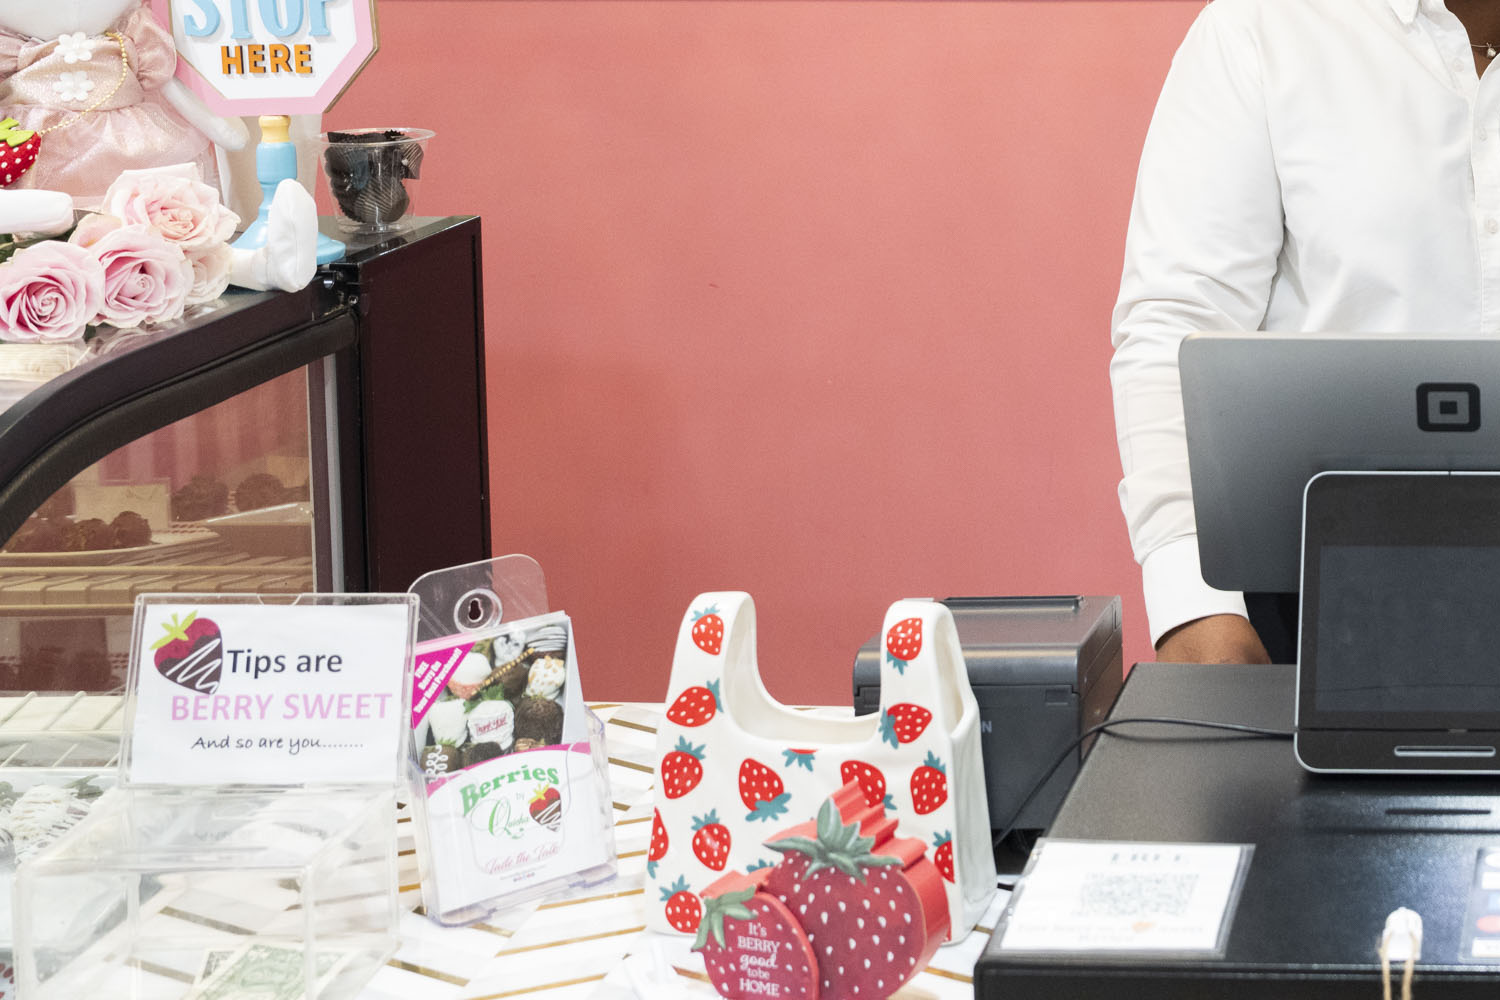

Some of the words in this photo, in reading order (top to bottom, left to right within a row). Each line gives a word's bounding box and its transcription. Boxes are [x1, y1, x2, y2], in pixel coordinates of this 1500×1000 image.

[220, 43, 313, 75] HERE
[227, 650, 286, 678] Tips
[296, 652, 343, 673] are
[171, 694, 273, 721] BERRY
[282, 693, 393, 719] SWEET
[190, 735, 230, 749] And
[236, 738, 253, 748] so
[258, 738, 284, 749] are
[460, 764, 560, 818] Berries
[748, 921, 768, 938] It's
[737, 935, 781, 954] BERRY
[739, 952, 779, 972] good
[738, 977, 781, 998] HOME
